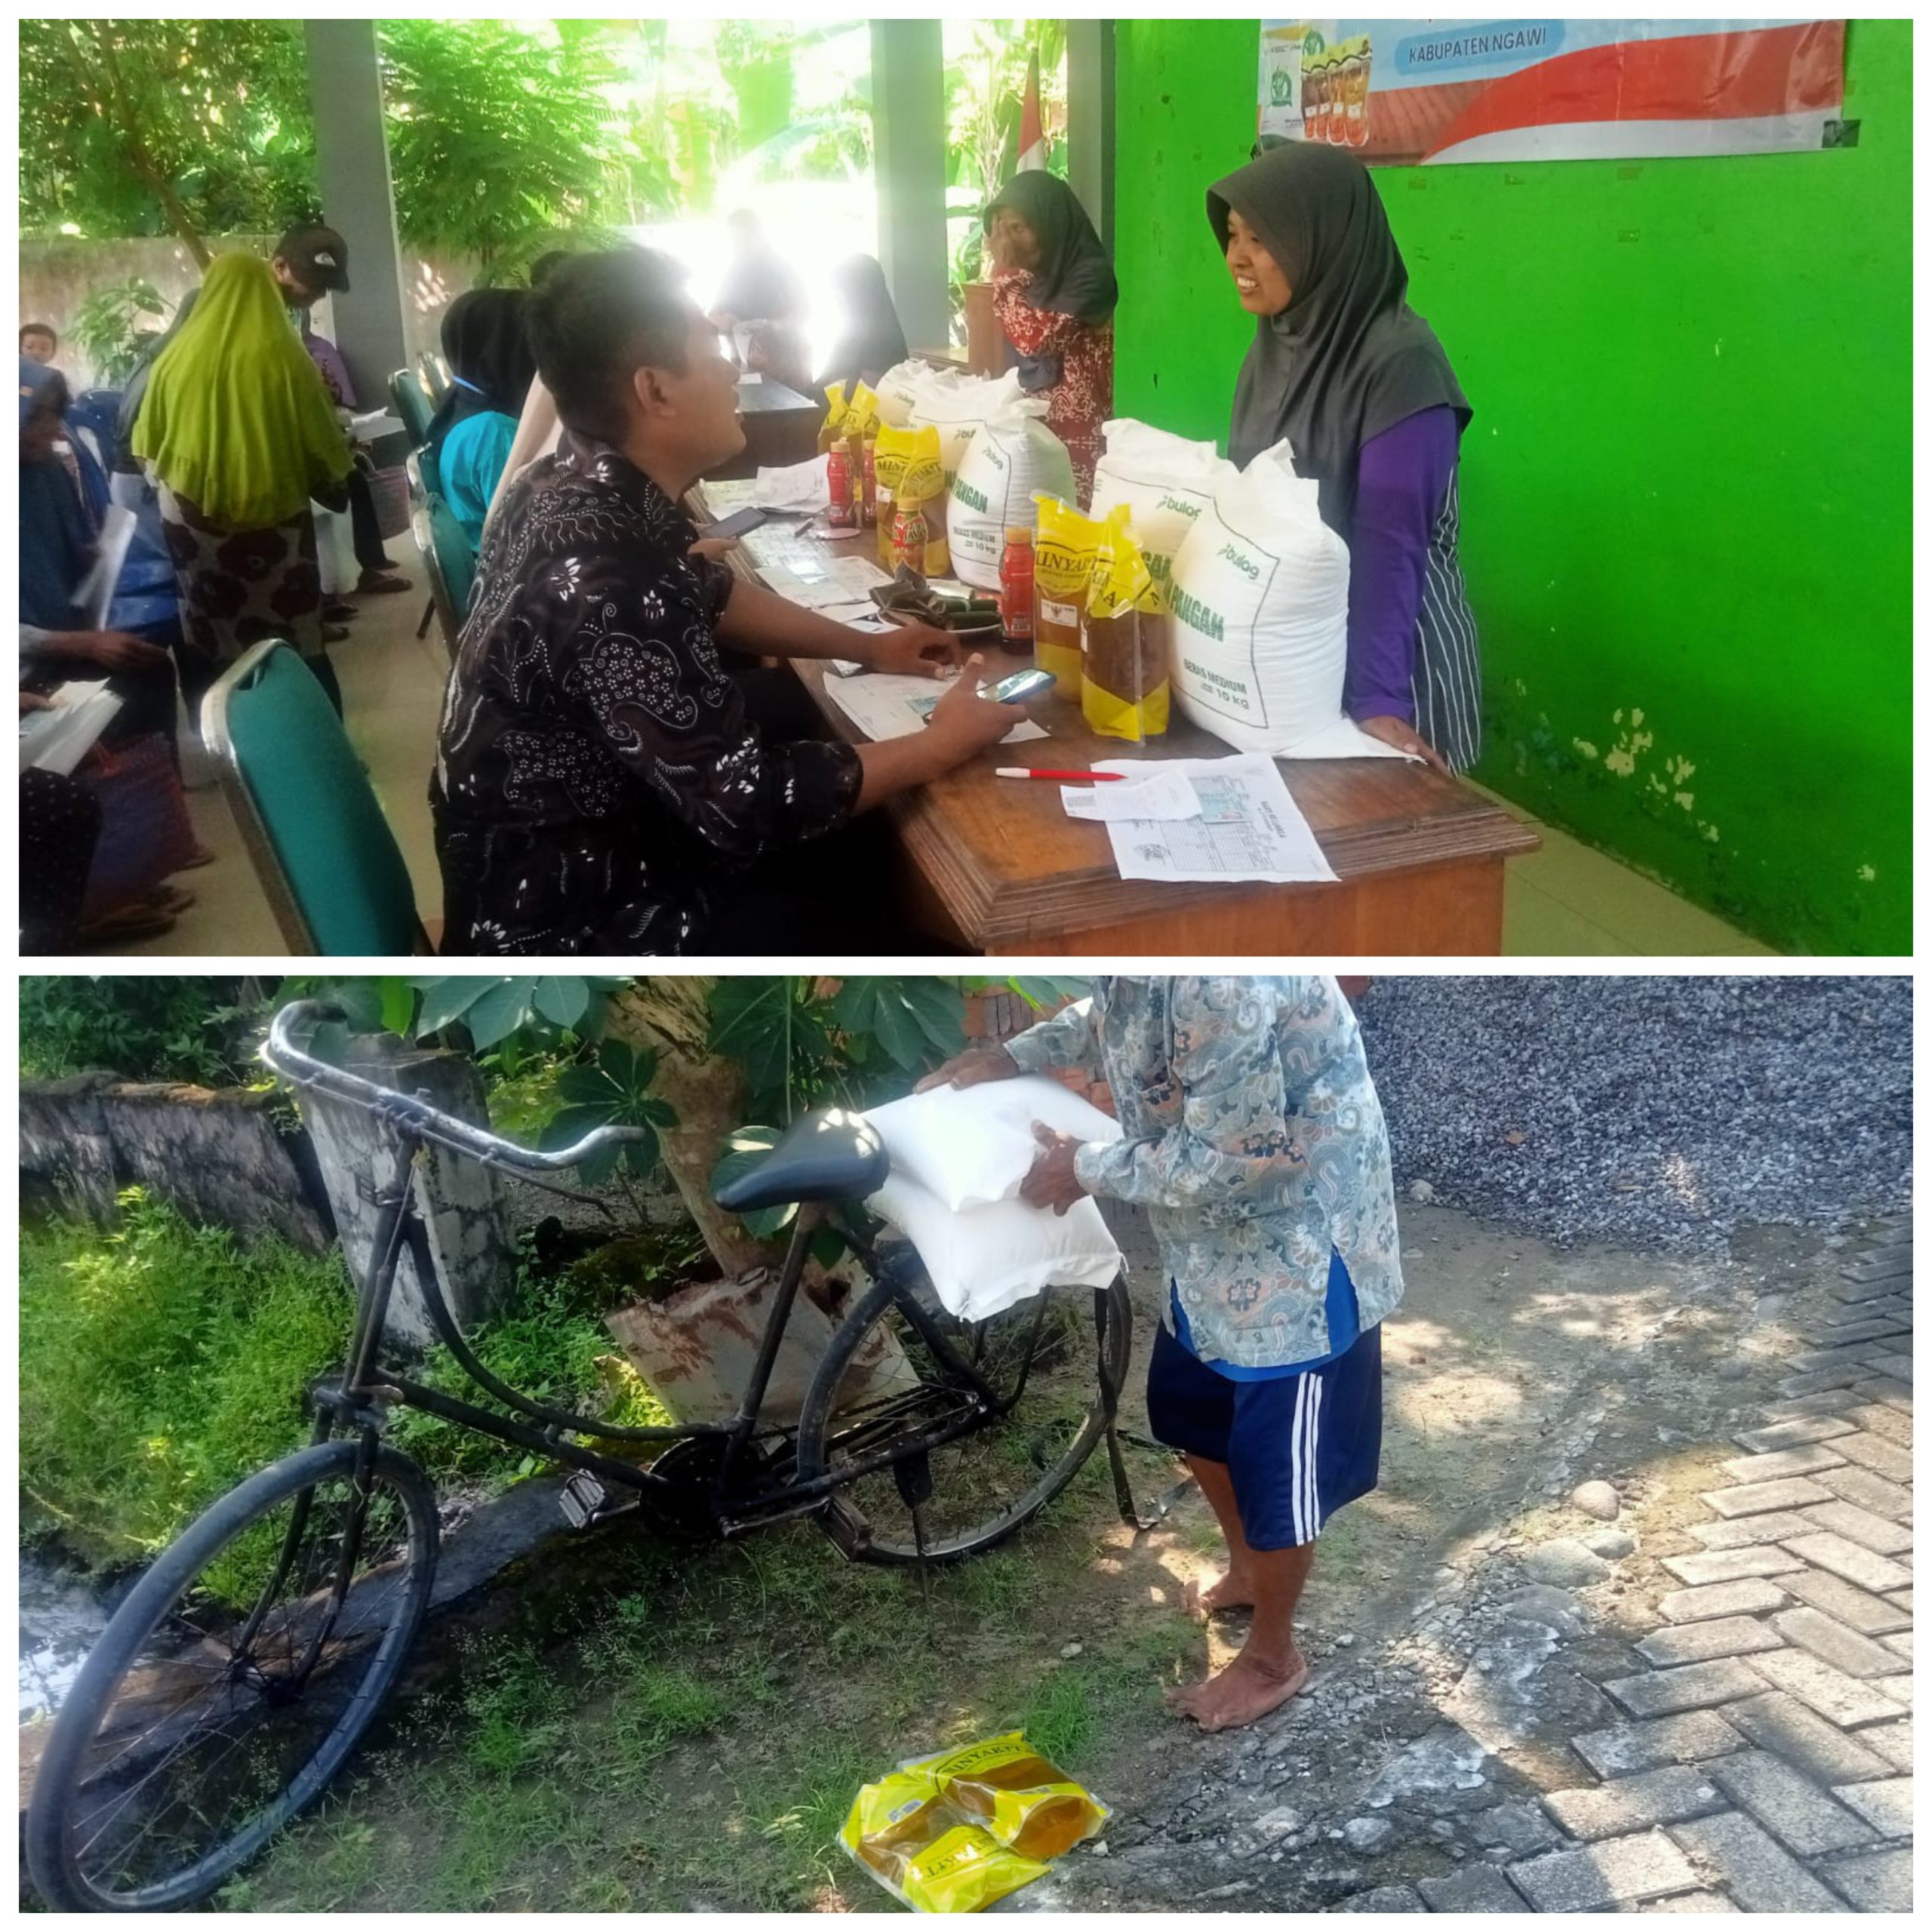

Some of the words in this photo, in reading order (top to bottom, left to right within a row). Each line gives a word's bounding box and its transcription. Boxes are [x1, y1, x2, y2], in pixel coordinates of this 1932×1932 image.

[1409, 36, 1488, 63] KABUPATEN
[1493, 27, 1546, 51] NGAWI
[1226, 544, 1260, 580] bulog
[1171, 583, 1224, 641] PANGAN
[1183, 658, 1207, 679] BERAS
[1207, 670, 1247, 694] MEDIUM
[1217, 688, 1230, 702] 10
